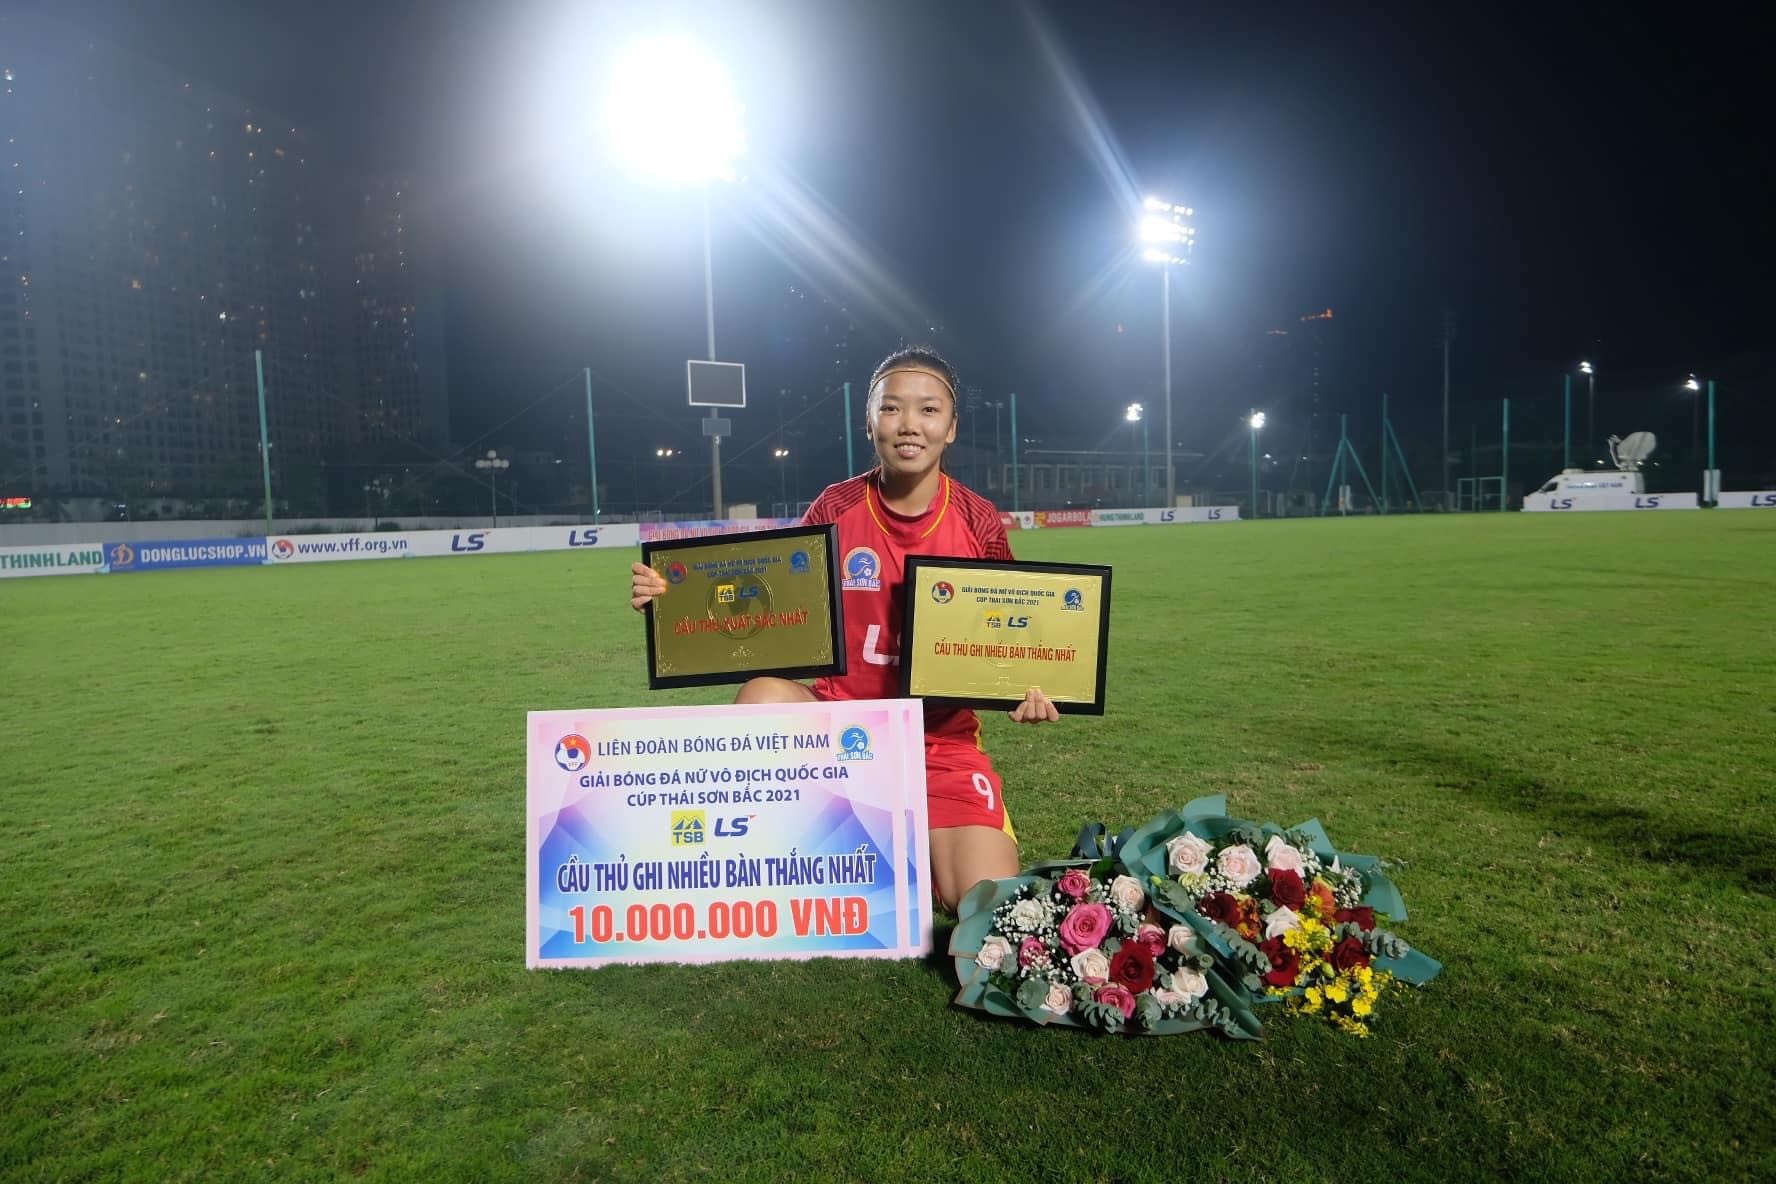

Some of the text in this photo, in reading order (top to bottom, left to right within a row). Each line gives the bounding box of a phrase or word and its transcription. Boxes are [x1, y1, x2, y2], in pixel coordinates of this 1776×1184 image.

[1550, 498, 1572, 509] LS
[1634, 497, 1659, 508] LS
[1751, 495, 1776, 506] LS
[1160, 510, 1175, 522] LS
[1207, 509, 1221, 520] LS
[298, 538, 408, 554] www.vff.org.vn
[451, 533, 485, 552] LS
[569, 529, 599, 547] LS
[140, 543, 266, 563] DONGLUCSHOP.VN
[739, 586, 759, 599] LS
[1007, 616, 1029, 628] LS
[969, 643, 983, 657] GHI
[598, 733, 831, 756] LIÊN ĐOÀN BÓNG ĐÁ VIỆT NAM
[580, 763, 849, 788] GIẢI BÓNG ĐÁ NỮ VÔ ĐỊCH QUỐC GIA
[627, 786, 800, 807] CÚP THÁI SƠN BẮC 2021
[971, 772, 995, 811] 9
[673, 817, 749, 844] TSB LS
[557, 844, 876, 893] CẦU THỦ GHI NHIỀU BÀN THẮNG NHẤT
[569, 896, 869, 943] 10.000.000 VNĐ
